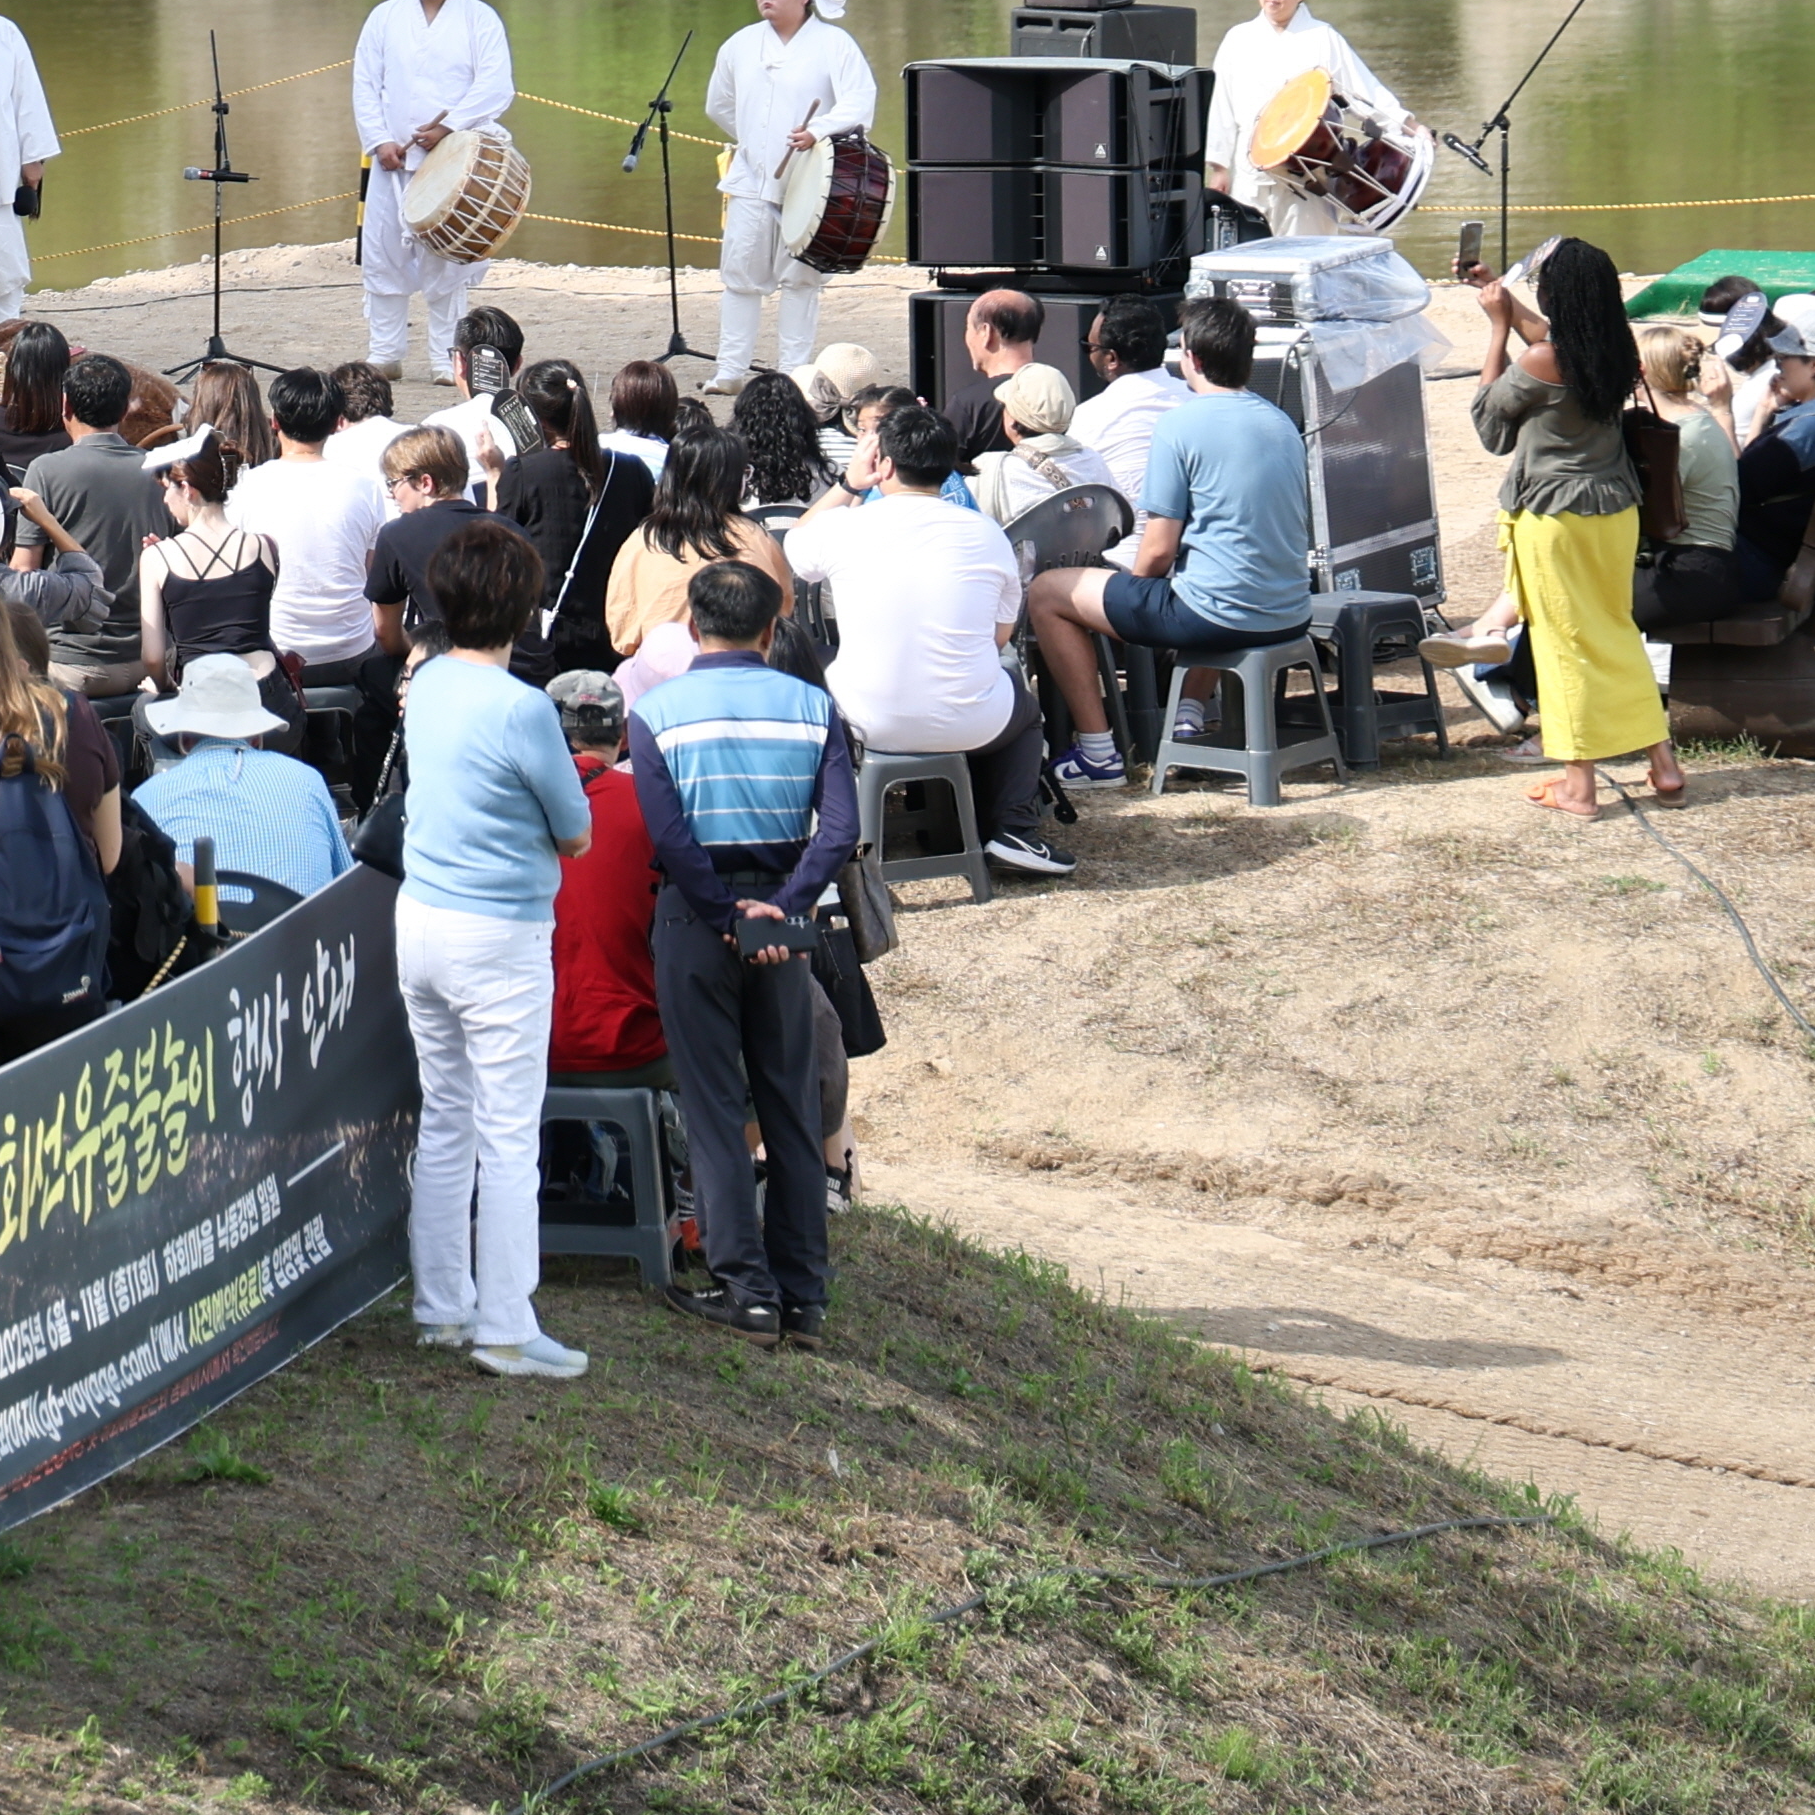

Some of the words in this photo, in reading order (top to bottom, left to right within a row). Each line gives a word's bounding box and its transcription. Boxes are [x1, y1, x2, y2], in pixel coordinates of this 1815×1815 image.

[227, 972, 289, 1128] 행사
[302, 932, 355, 1069] 안내
[46, 1297, 72, 1352] 6월
[80, 1277, 110, 1332] 11월
[109, 1249, 160, 1318] (총11회)
[163, 1217, 215, 1284] 하회마을
[217, 1188, 259, 1253] 낙동강변
[257, 1172, 281, 1227] 일원
